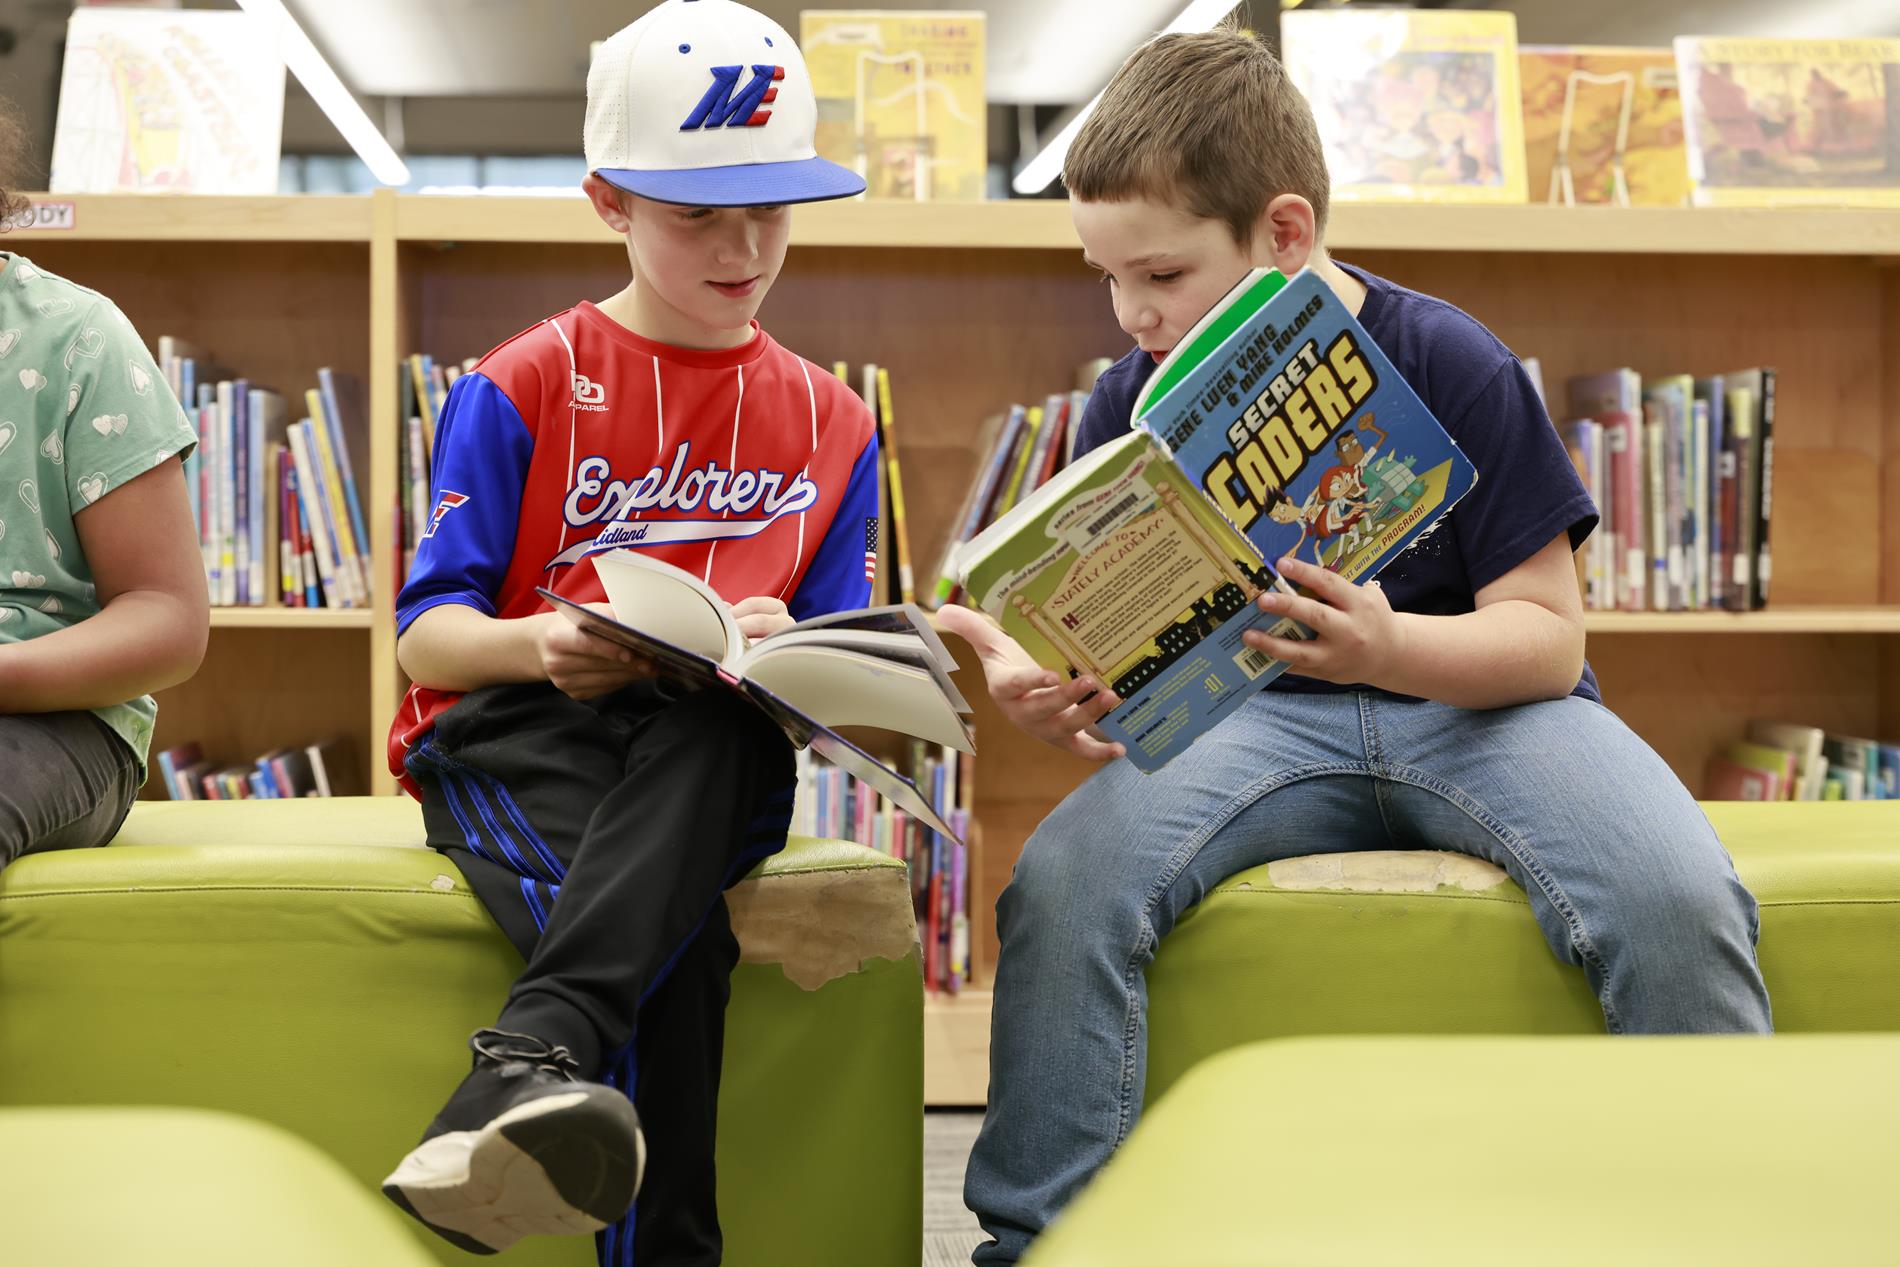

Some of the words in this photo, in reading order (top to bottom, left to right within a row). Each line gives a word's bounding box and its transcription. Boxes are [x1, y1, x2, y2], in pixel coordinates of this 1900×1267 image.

[1166, 409, 1203, 453] GENE
[1201, 369, 1238, 413] LUEN
[1235, 323, 1279, 371] YANG
[1226, 391, 1241, 408] &
[1240, 351, 1275, 394] MIKE
[1272, 294, 1324, 355] HOLMES
[1226, 339, 1319, 451] SECRET
[1205, 332, 1376, 533] CODERS
[564, 441, 818, 529] Explorers
[1054, 509, 1075, 529] series
[1381, 504, 1426, 546] PROGRAM!
[1053, 567, 1100, 607] STATELY
[1103, 518, 1160, 572] ACADEMY
